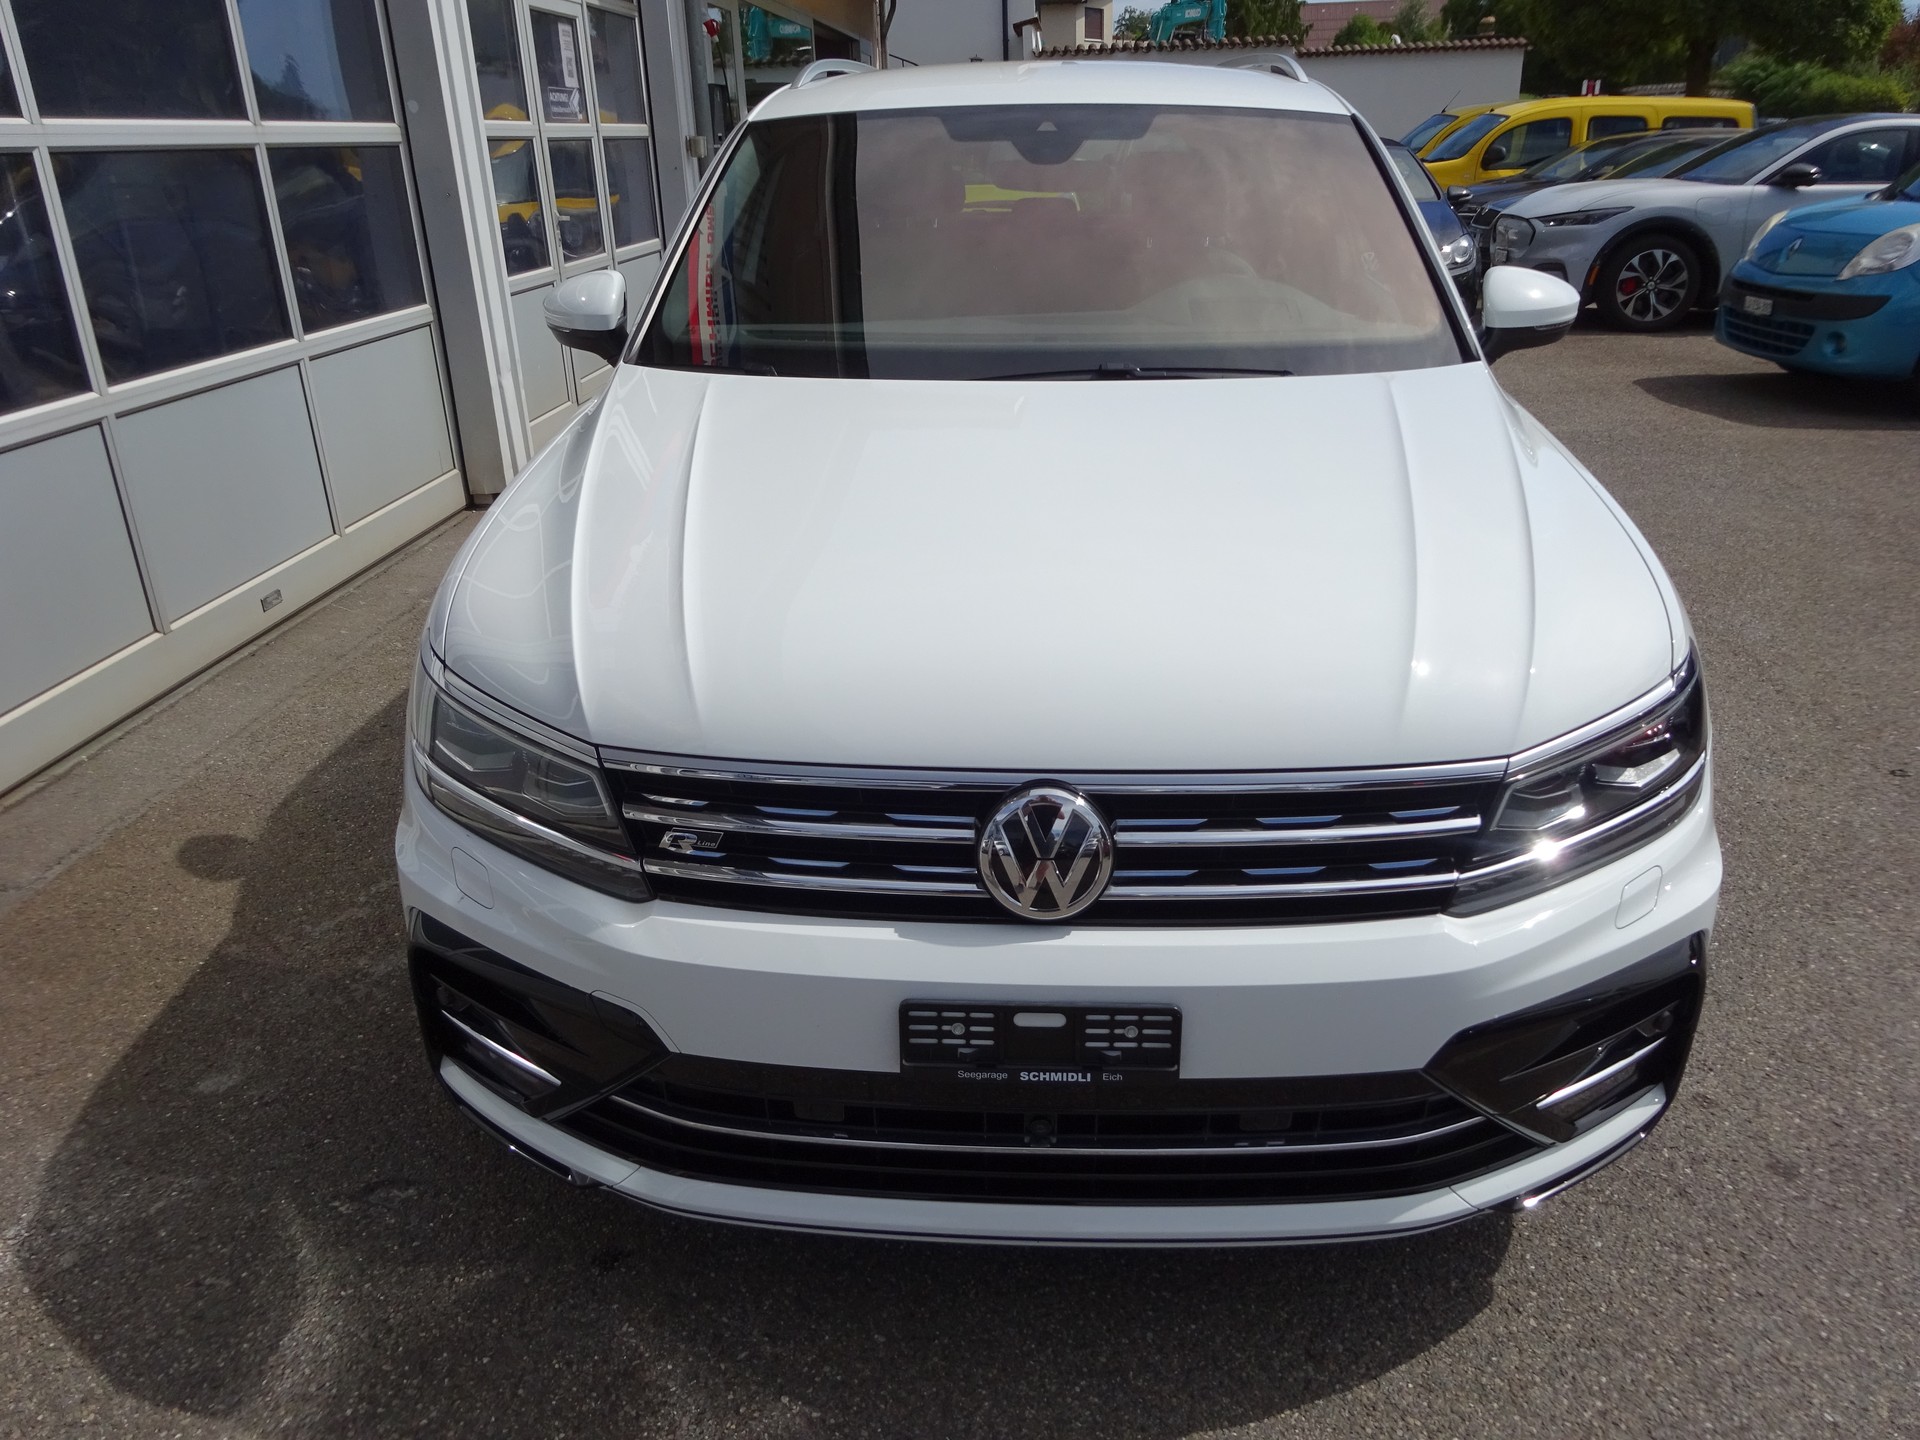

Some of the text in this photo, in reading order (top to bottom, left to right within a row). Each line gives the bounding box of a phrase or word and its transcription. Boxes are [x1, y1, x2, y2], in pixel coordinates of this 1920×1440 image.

[957, 1070, 1123, 1082] Seegarage SCHMIDLI Eich
